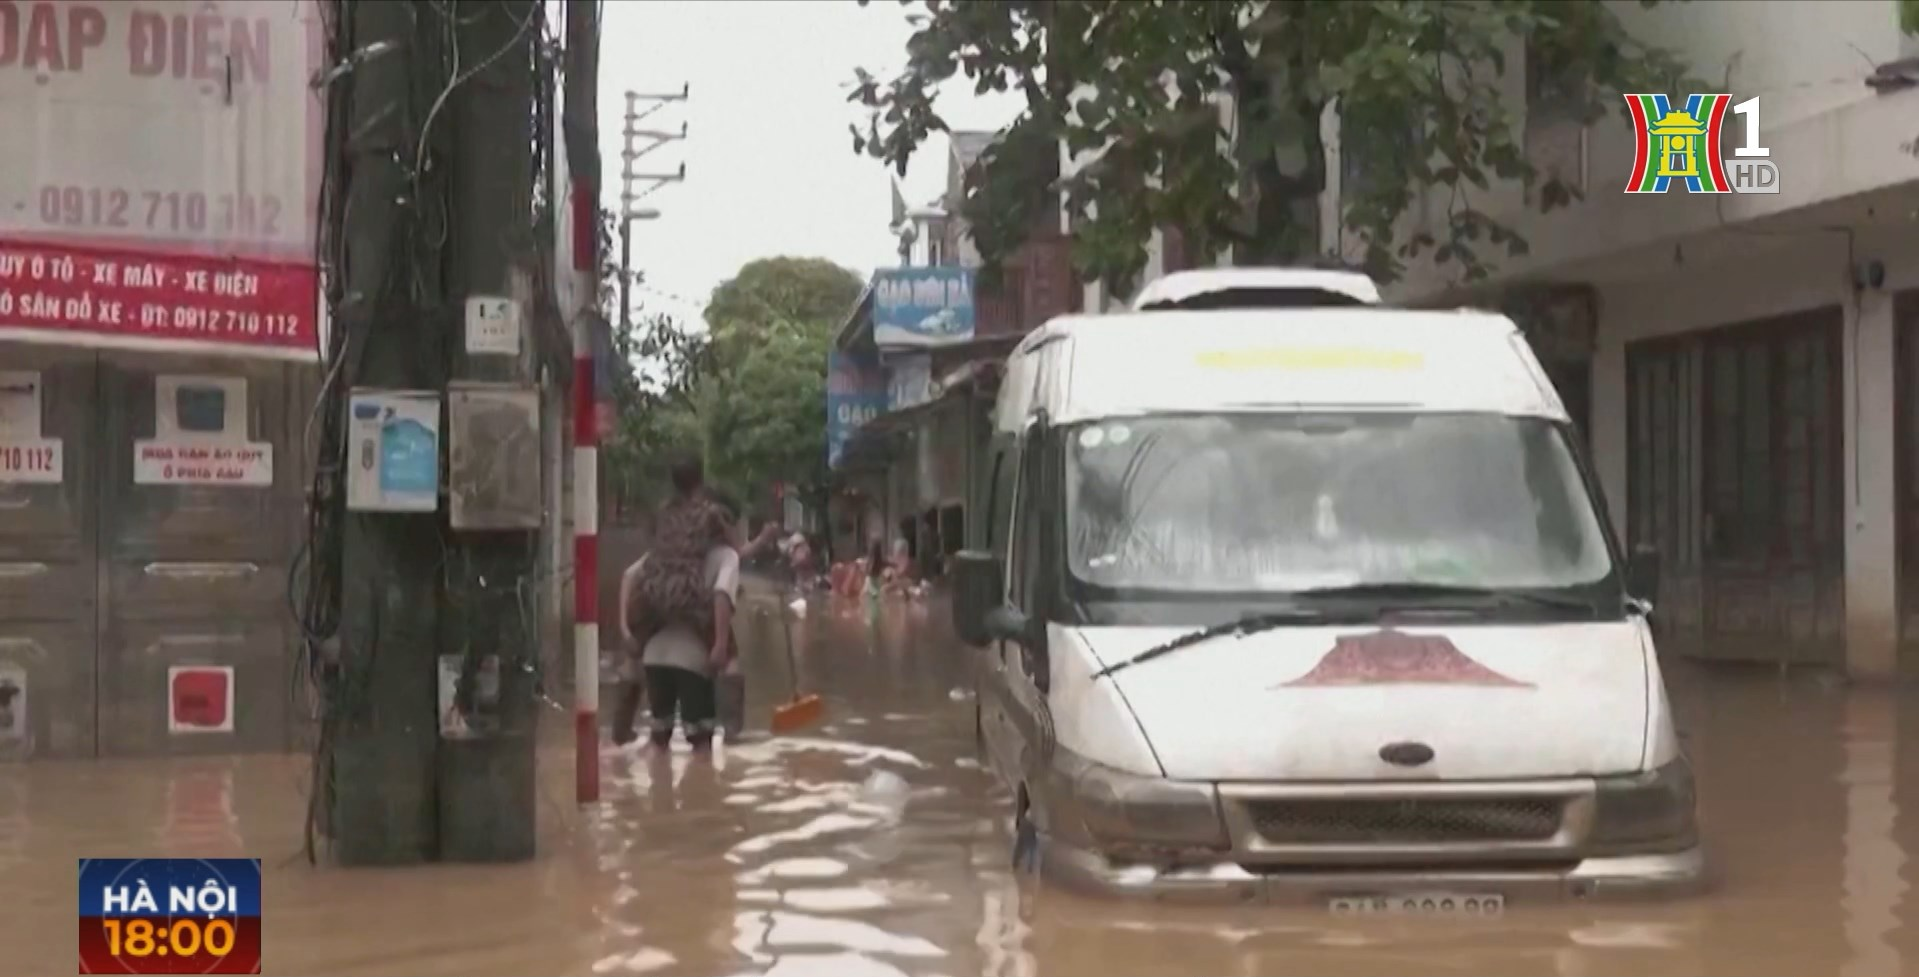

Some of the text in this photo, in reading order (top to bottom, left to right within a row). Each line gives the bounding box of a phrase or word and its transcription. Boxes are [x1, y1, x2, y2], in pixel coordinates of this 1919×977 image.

[40, 185, 129, 227] 0912
[143, 190, 207, 231] 710
[92, 261, 117, 287] XE
[185, 269, 210, 293] XE
[98, 299, 123, 324] XE
[174, 306, 219, 333] 0912
[226, 312, 260, 335] 710
[266, 313, 299, 337] 112
[27, 447, 54, 471] 112
